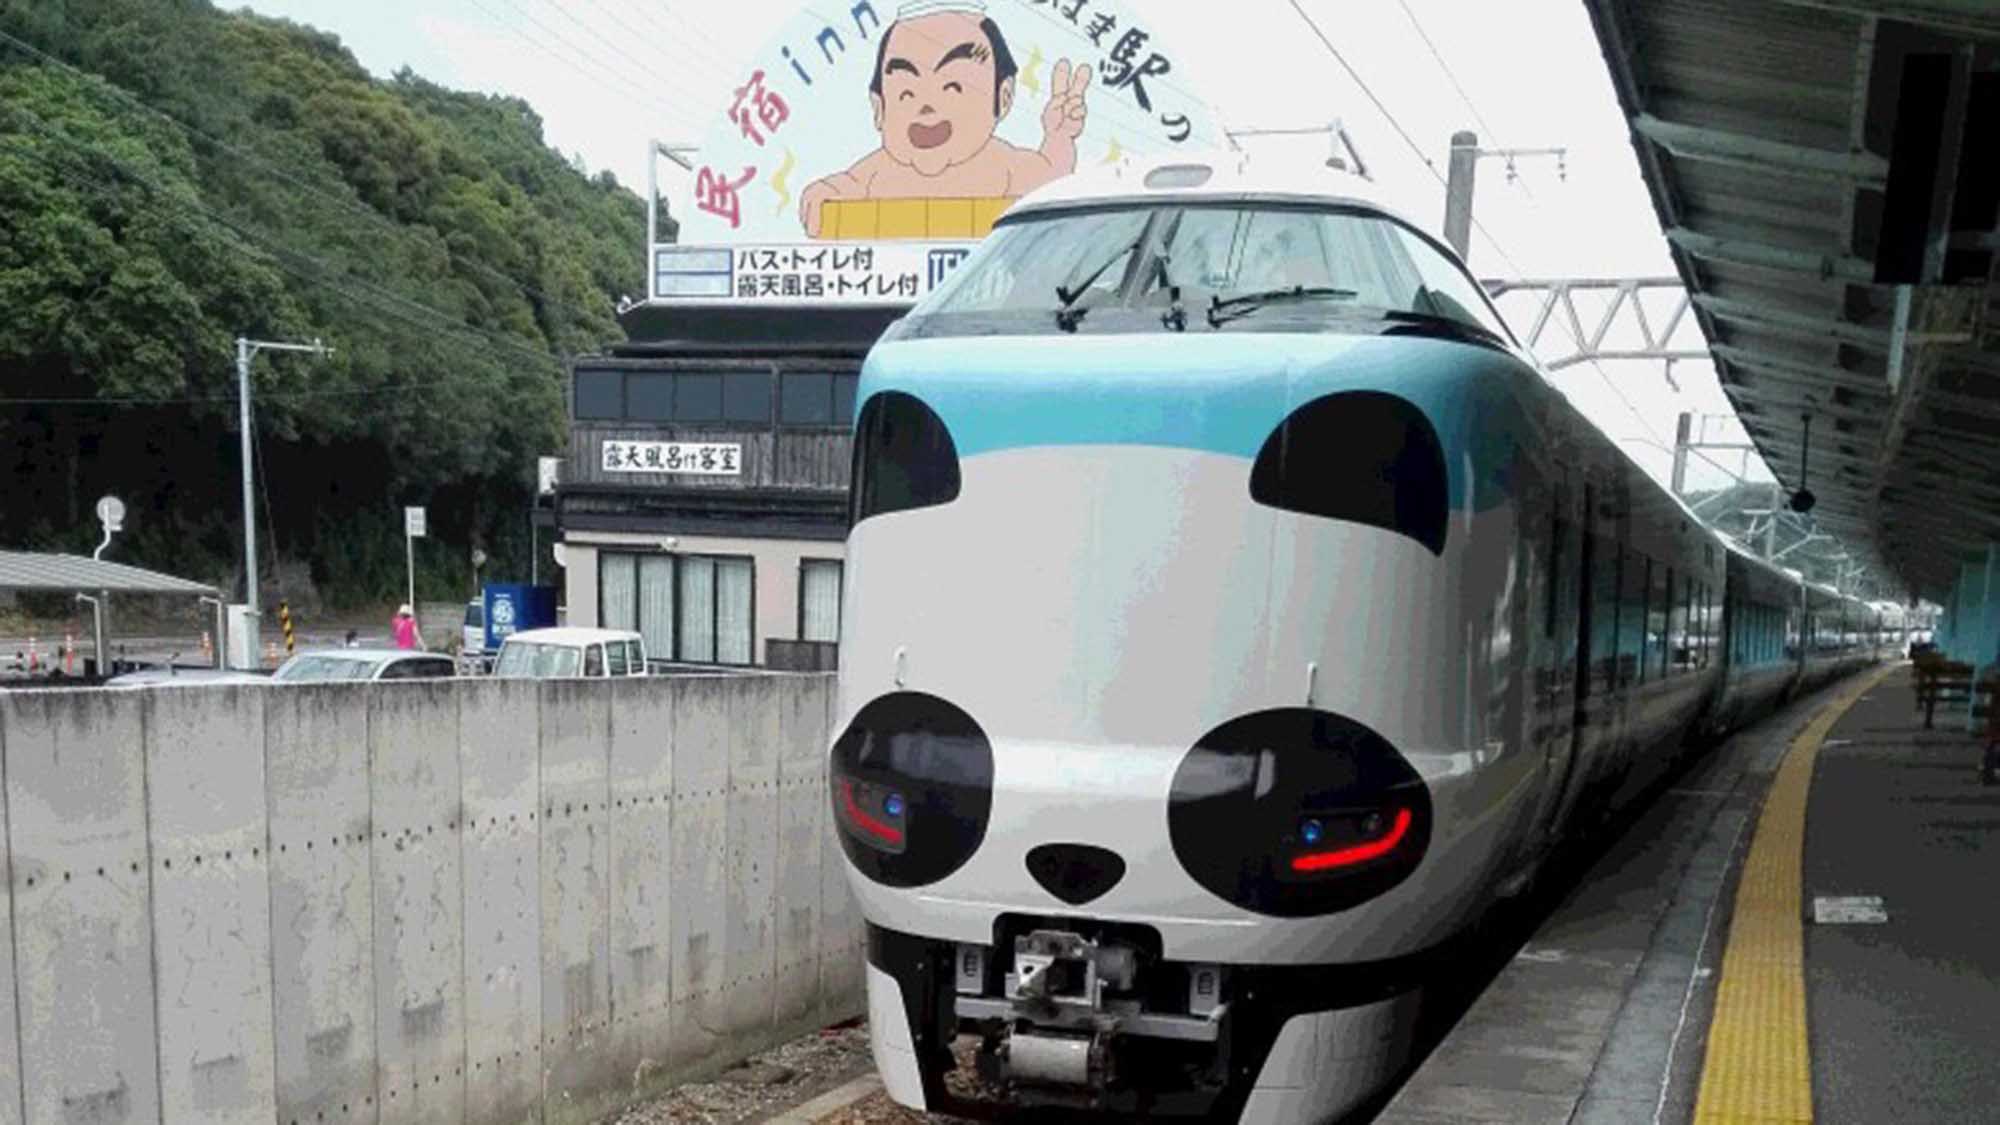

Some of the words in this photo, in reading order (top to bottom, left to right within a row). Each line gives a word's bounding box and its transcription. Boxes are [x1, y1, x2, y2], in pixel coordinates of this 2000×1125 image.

[738, 248, 872, 271] バス・トイレ付
